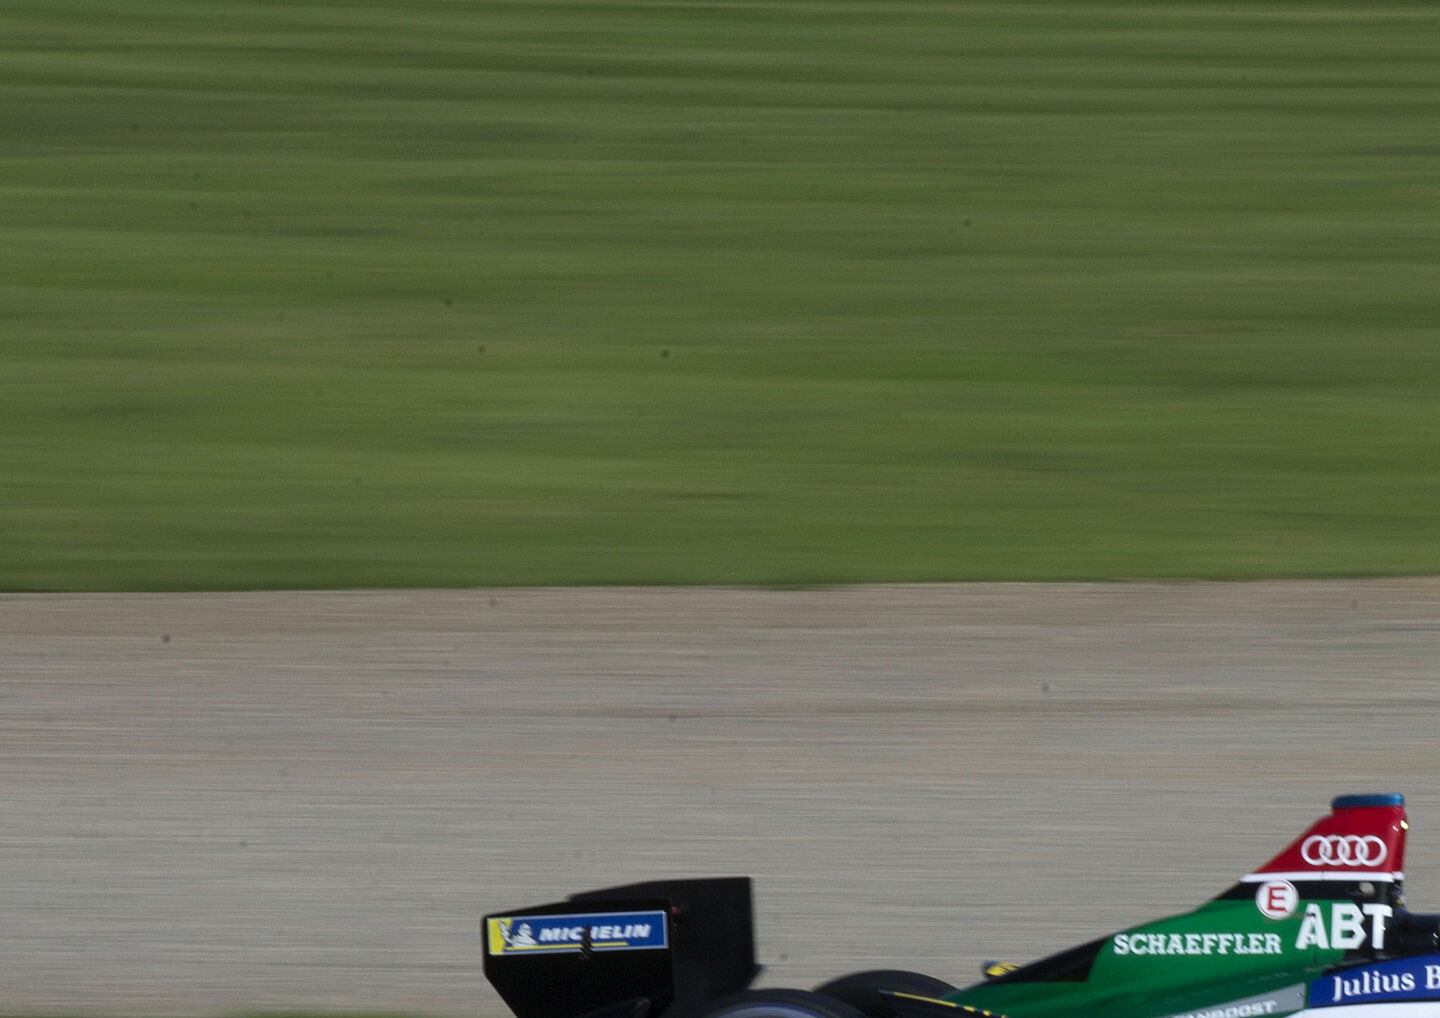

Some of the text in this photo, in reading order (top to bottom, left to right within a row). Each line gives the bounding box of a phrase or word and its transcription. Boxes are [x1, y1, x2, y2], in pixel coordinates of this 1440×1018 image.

[1267, 886, 1288, 912] E
[1295, 903, 1393, 950] ABT
[1113, 933, 1282, 955] SCHAEFFLER
[1332, 970, 1415, 1002] Julius
